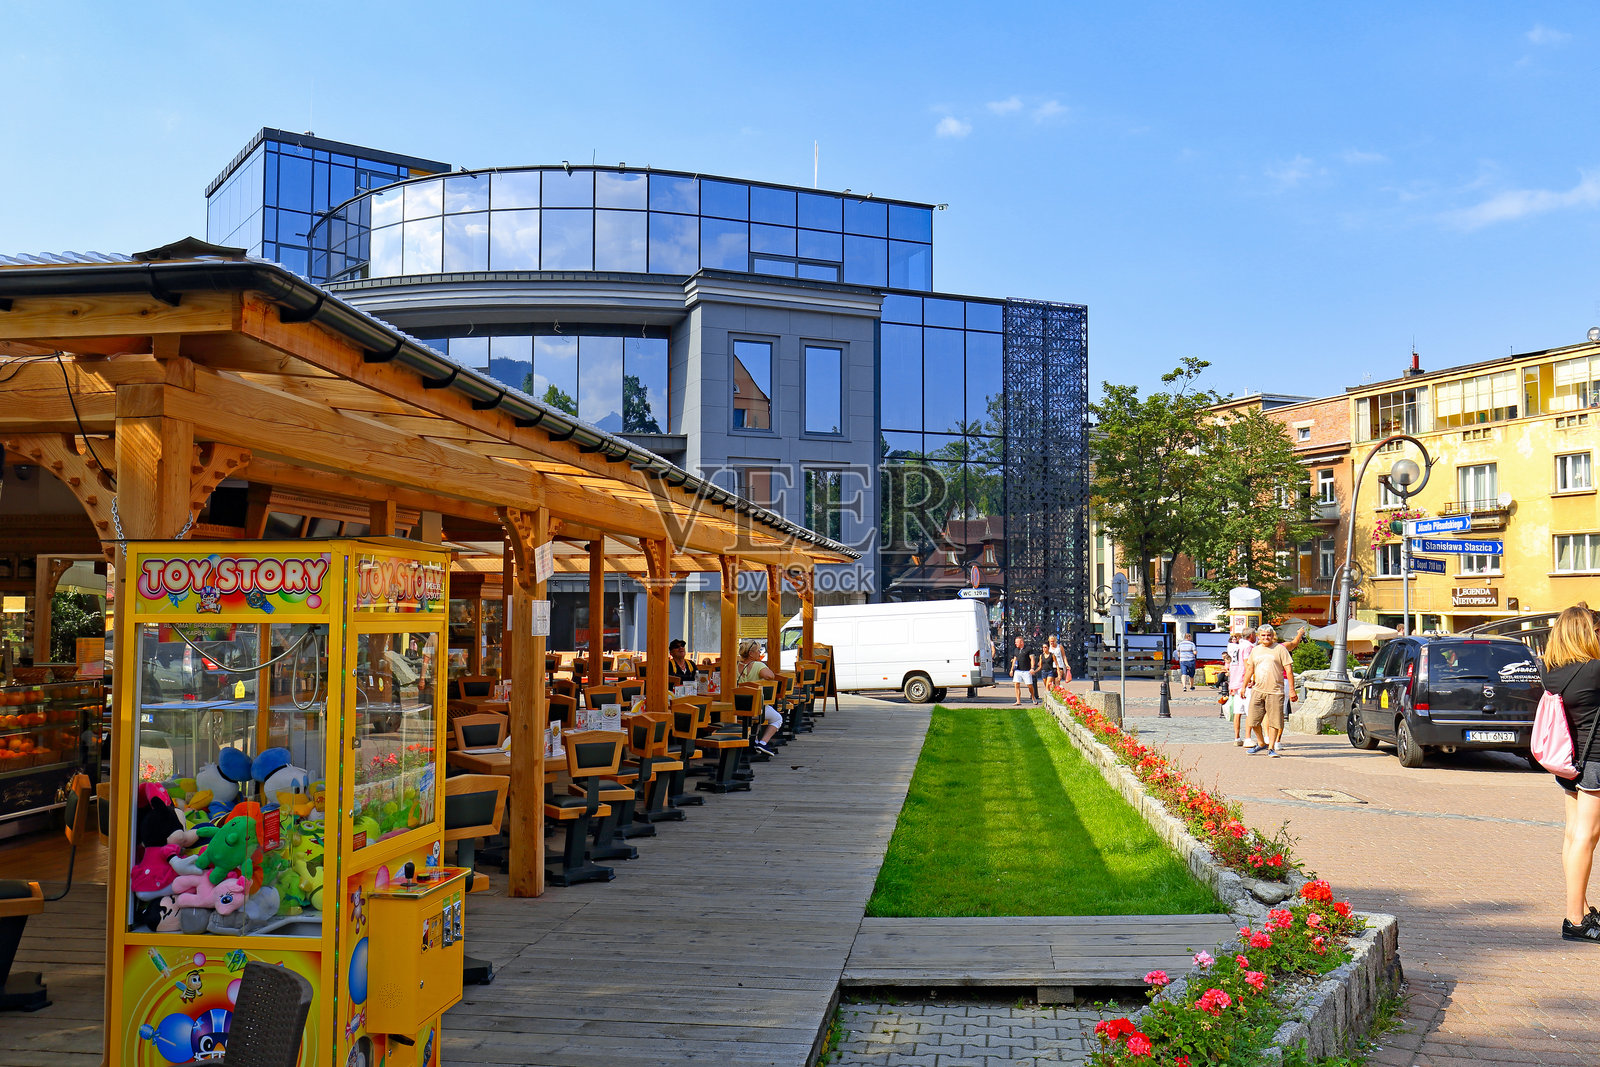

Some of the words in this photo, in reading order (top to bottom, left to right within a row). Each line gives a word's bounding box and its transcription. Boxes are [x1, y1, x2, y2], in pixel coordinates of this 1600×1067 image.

[1425, 541, 1462, 551] Stanisława
[1464, 542, 1492, 552] Staszica
[141, 557, 212, 595] TOY
[215, 557, 329, 595] STORY
[1456, 587, 1491, 596] LEGENDA
[1452, 597, 1497, 605] NIETOPERZA
[1471, 731, 1489, 740] KTT
[1493, 731, 1513, 741] 6N37
